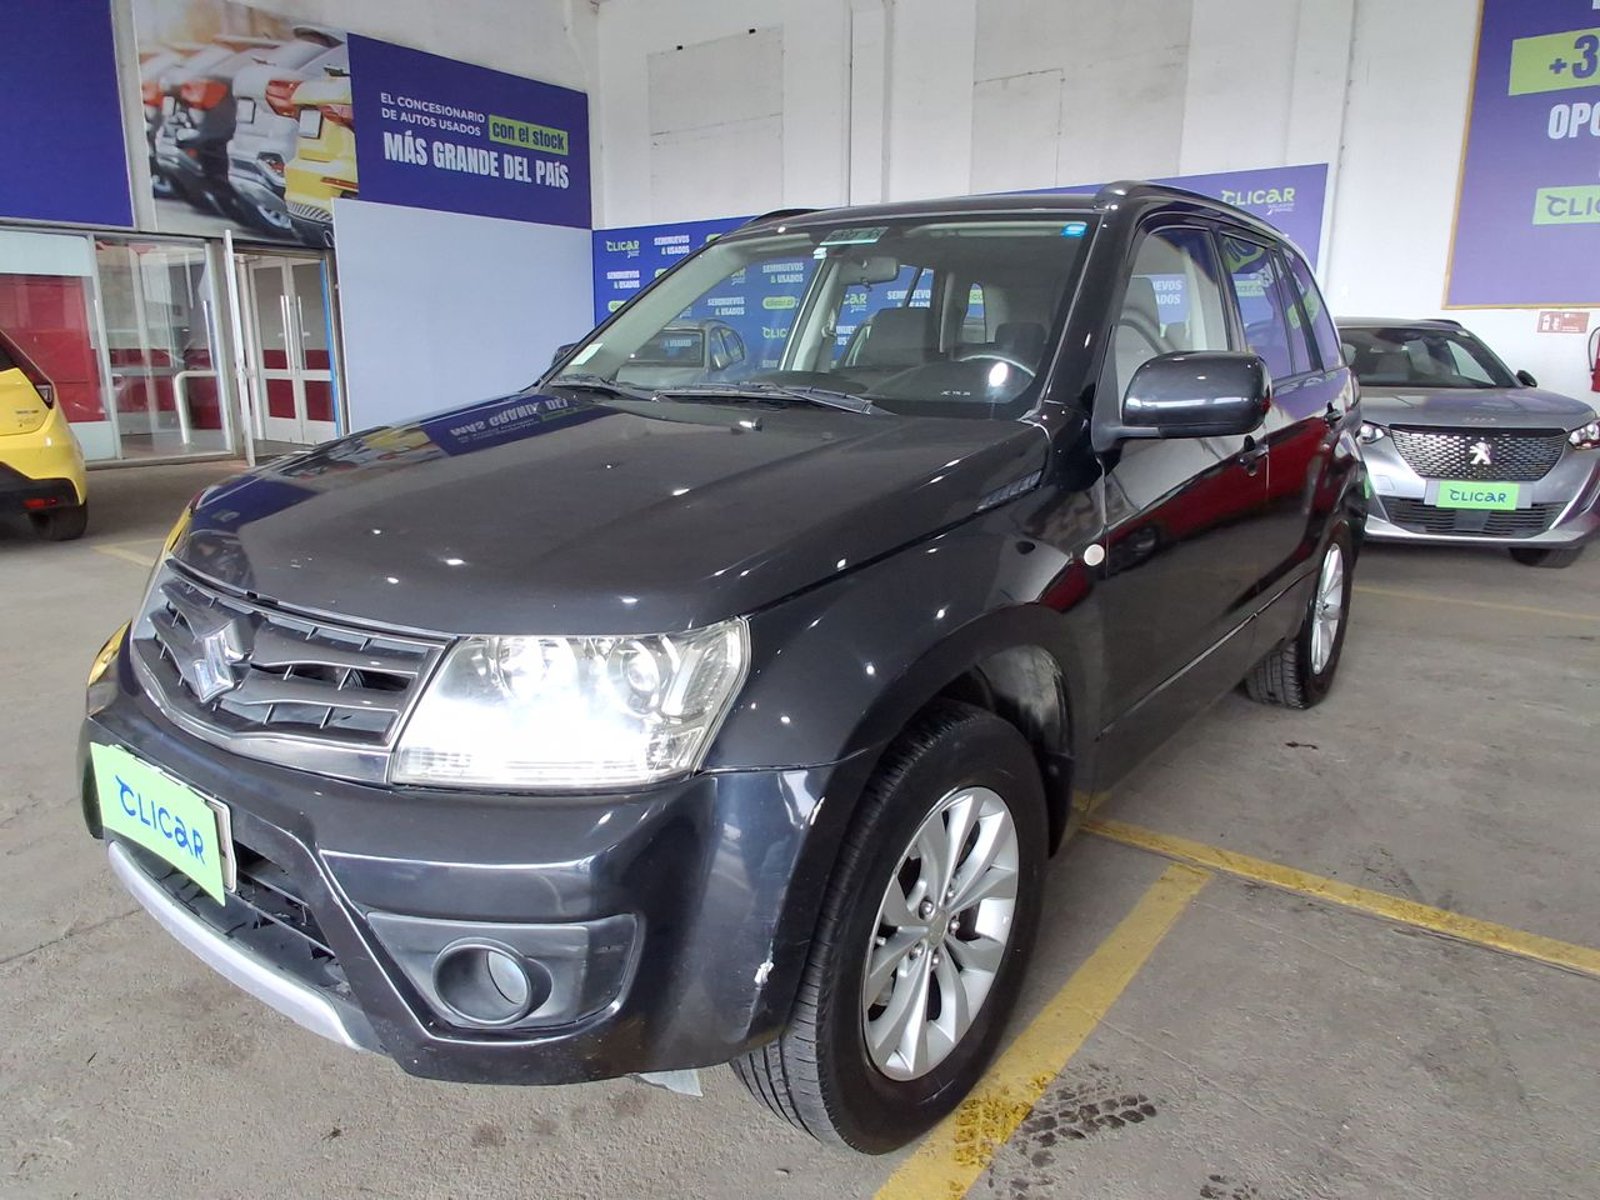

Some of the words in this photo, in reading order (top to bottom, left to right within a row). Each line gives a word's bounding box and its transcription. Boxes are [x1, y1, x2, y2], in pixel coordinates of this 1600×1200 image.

[380, 92, 393, 106] EL
[397, 96, 486, 123] CONCESIONARIO
[381, 107, 398, 121] DE
[400, 111, 437, 128] AUTOS
[439, 119, 481, 137] USADOS
[492, 121, 516, 140] con
[519, 128, 529, 143] el
[532, 132, 565, 150] stock
[383, 130, 428, 166] MÁS
[433, 141, 500, 177] GRANDE
[503, 154, 532, 183] DEL
[535, 160, 570, 189] PAÍS
